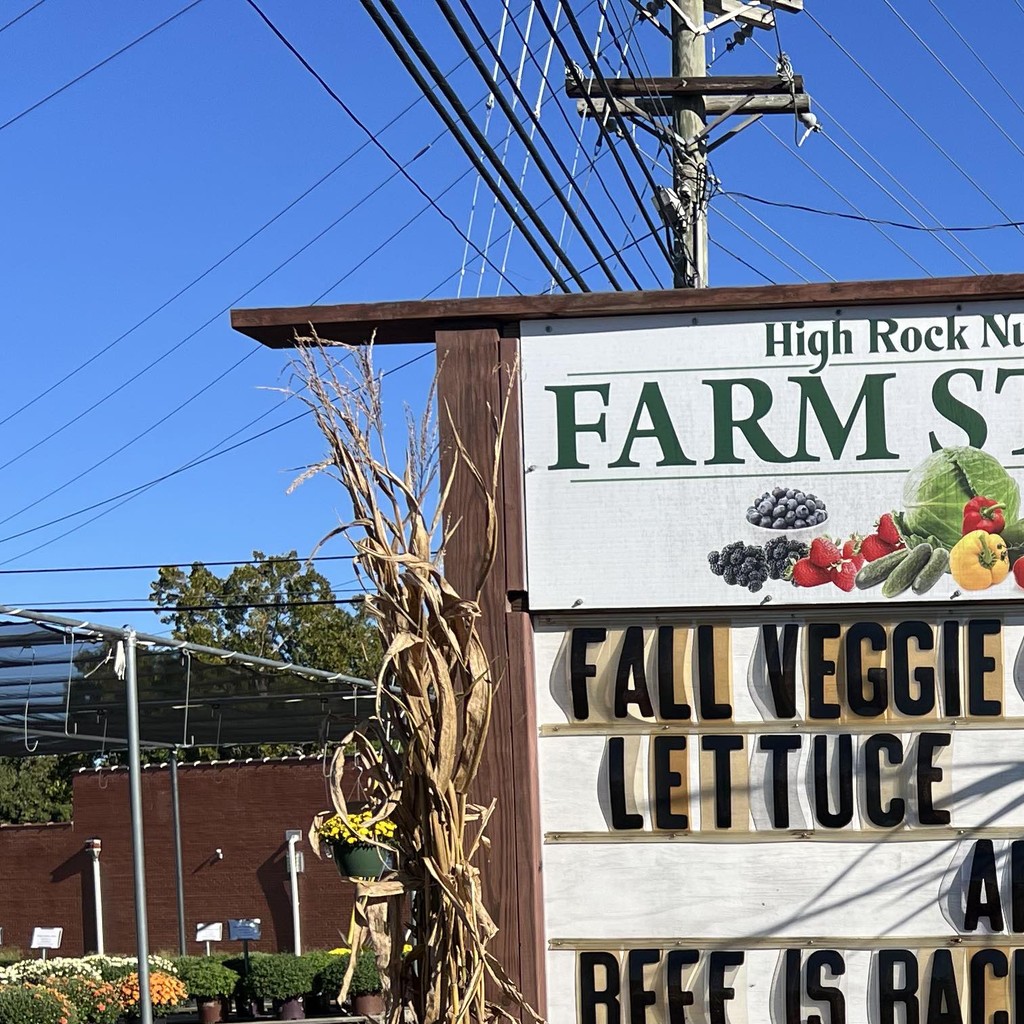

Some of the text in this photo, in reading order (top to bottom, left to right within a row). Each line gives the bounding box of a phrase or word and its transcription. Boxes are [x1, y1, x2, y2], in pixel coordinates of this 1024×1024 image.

[765, 319, 853, 374] High
[868, 315, 970, 354] Rock
[544, 371, 901, 471] FARM
[571, 624, 733, 720] FALL
[762, 619, 1001, 719] VEGGIE
[608, 732, 951, 830] LETTUCE
